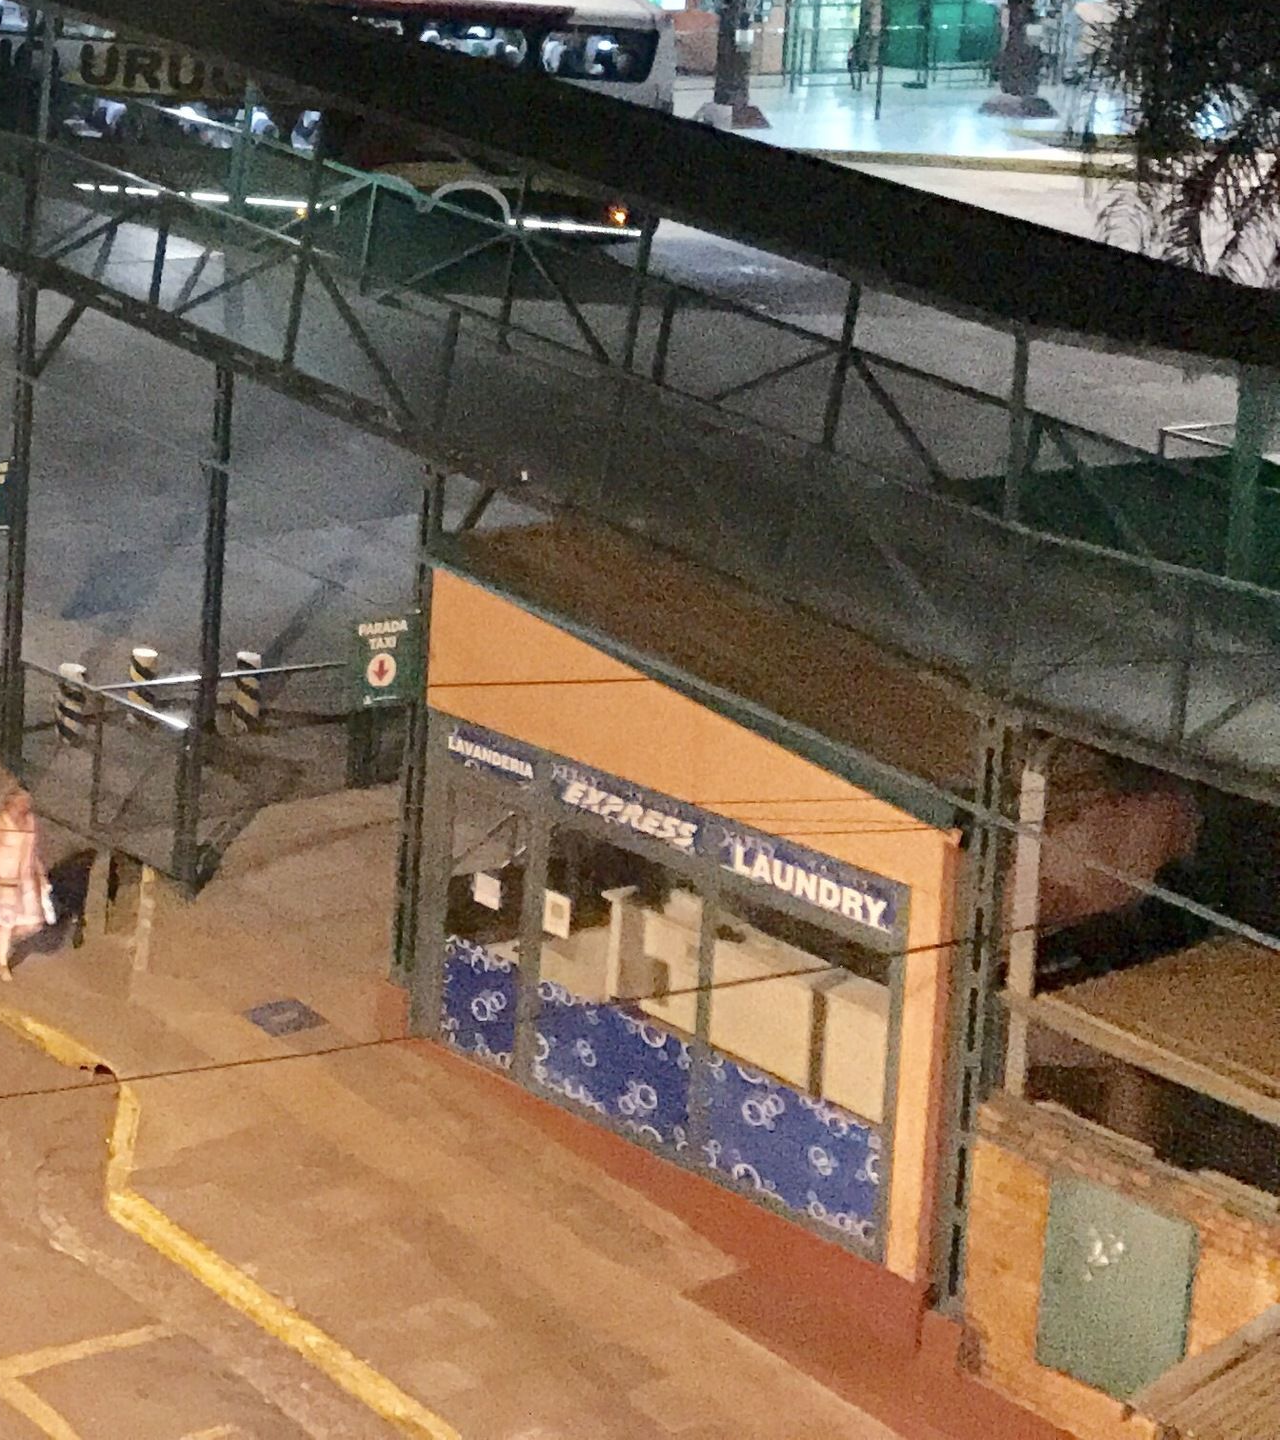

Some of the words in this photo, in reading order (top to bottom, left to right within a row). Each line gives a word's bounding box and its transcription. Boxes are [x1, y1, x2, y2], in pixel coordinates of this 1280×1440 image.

[358, 619, 408, 636] PARADA
[368, 636, 397, 650] TAXI
[561, 780, 699, 848] EXPRESS
[733, 843, 888, 930] LAUNDRY
